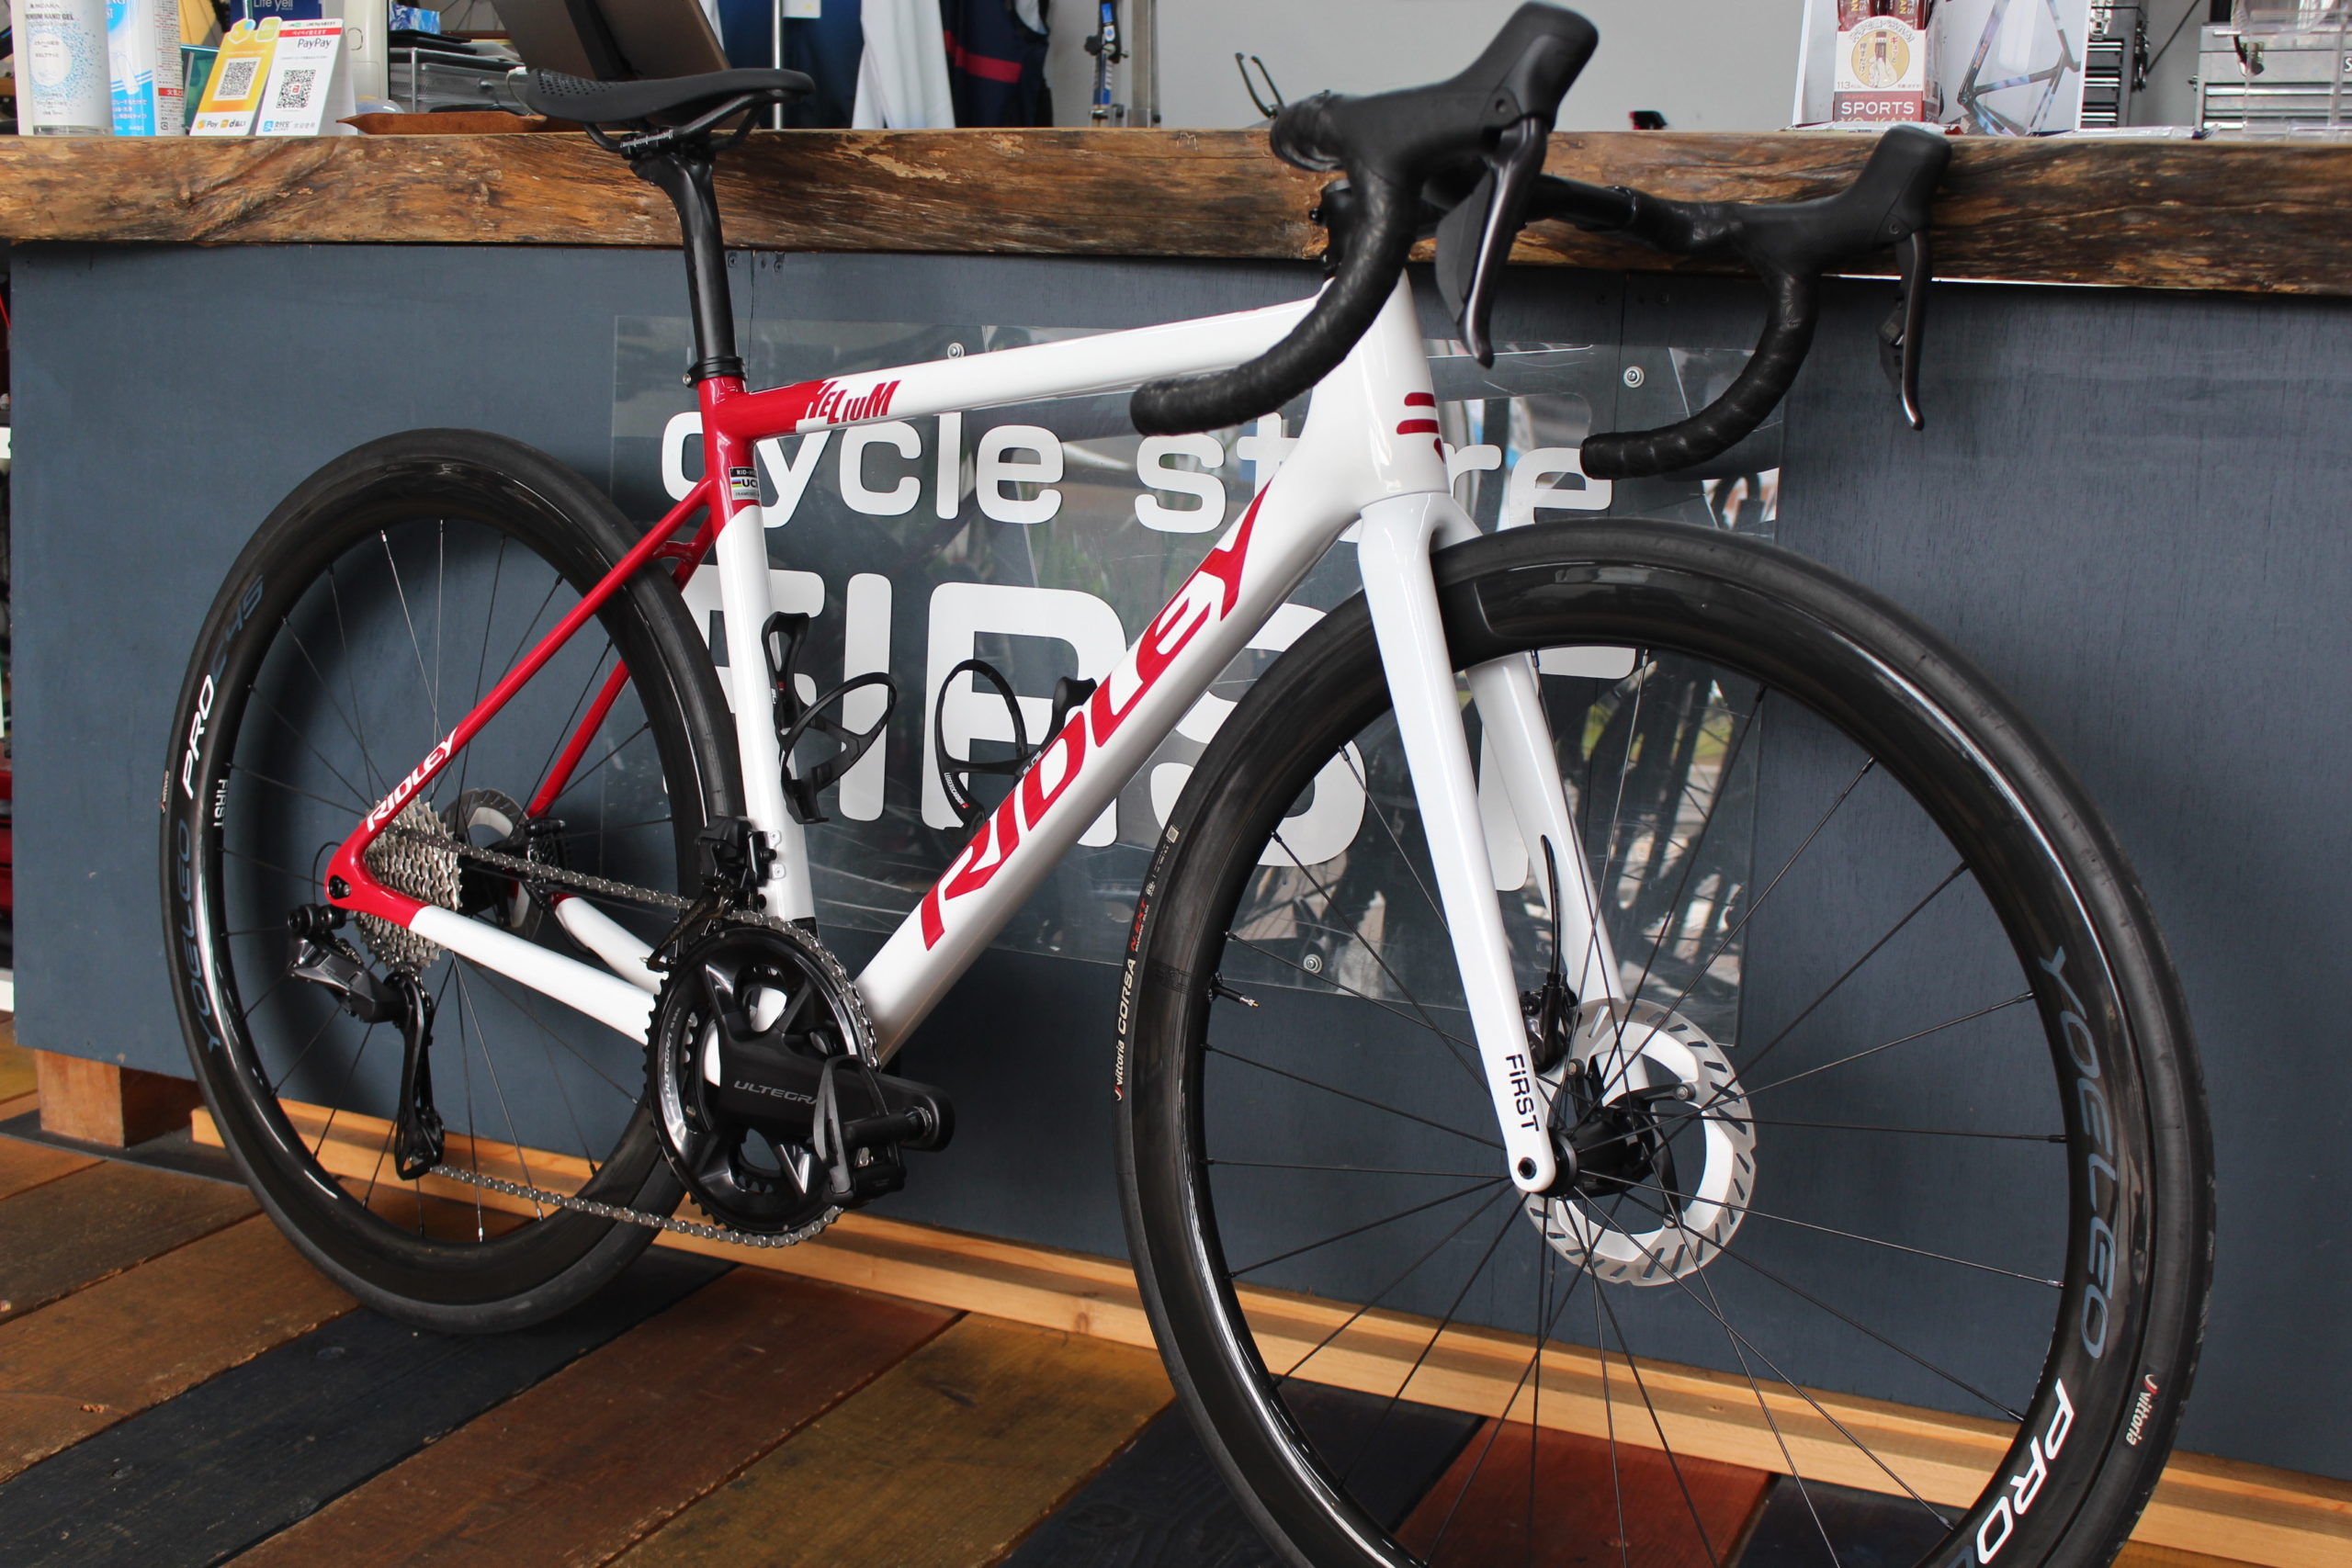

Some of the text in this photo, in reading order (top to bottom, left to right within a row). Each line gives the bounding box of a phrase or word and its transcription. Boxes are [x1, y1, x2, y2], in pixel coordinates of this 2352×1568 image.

[297, 38, 332, 50] PayPay
[1840, 101, 1915, 115] SPORTS
[662, 411, 1612, 544] cycle stre
[182, 673, 215, 800] PRO
[921, 479, 1273, 952] RIDLEY
[213, 778, 230, 827] FIRST
[367, 726, 459, 832] RIDLEY
[177, 818, 221, 1054] YOELEO
[1117, 958, 1136, 1036] CORSA
[663, 1032, 673, 1099] ULTEGRA
[1114, 1040, 1125, 1086] vittoria
[1505, 1053, 1541, 1133] FIRST
[1976, 945, 2117, 1565] YOELEO PRO
[2125, 1392, 2153, 1446] vittoria
